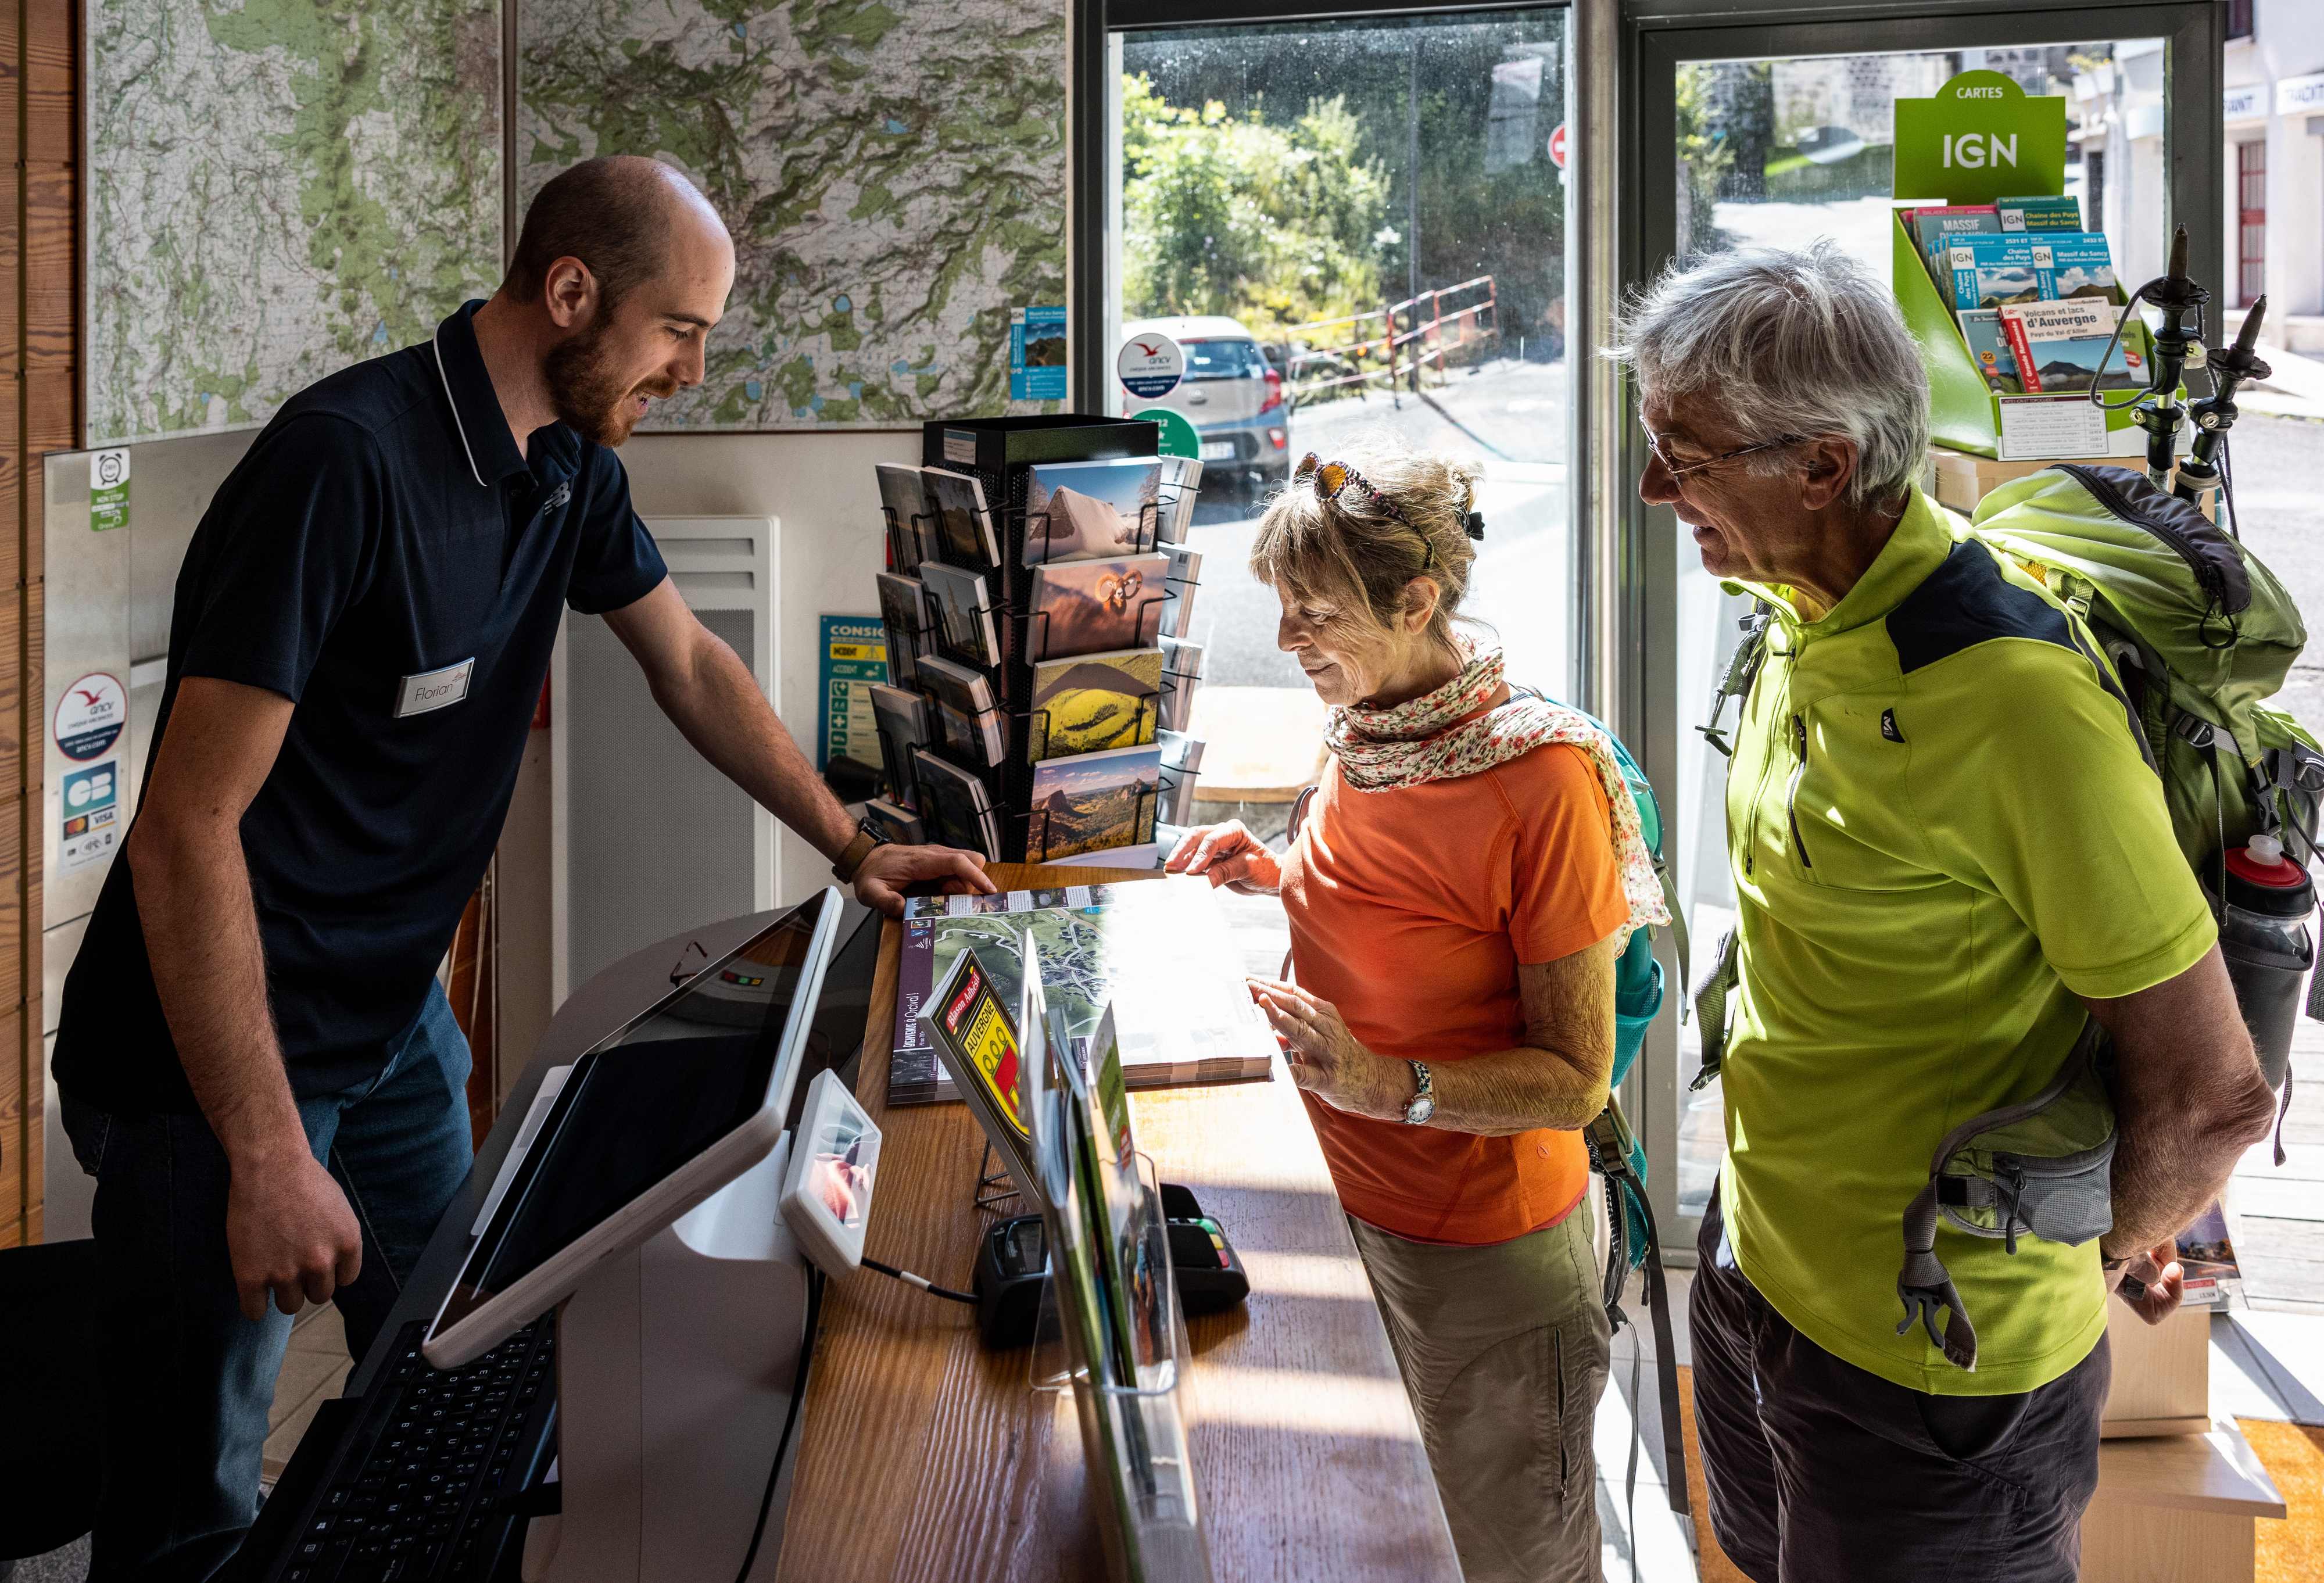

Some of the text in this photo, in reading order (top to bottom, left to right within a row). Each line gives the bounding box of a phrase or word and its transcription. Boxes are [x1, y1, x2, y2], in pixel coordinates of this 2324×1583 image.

[1956, 87, 2003, 99] CARTES
[1943, 132, 2018, 169] IGN
[1943, 219, 1980, 231] MASSIF
[2003, 215, 2023, 224] IGN
[1952, 253, 1973, 262] IGN
[2034, 252, 2051, 262] GN
[2024, 308, 2056, 318] Volcans
[2027, 314, 2097, 329] d'Auvergne
[1149, 356, 1172, 364] ancv
[2022, 354, 2033, 377] Grande
[415, 683, 453, 702] Florian
[90, 701, 114, 715] ancv
[95, 812, 113, 824] VISA
[947, 971, 980, 1027] Blason Adhésif
[904, 996, 919, 1018] Orcival
[968, 1000, 996, 1055] AUVERGNE
[903, 1022, 917, 1048] BIENVENUE
